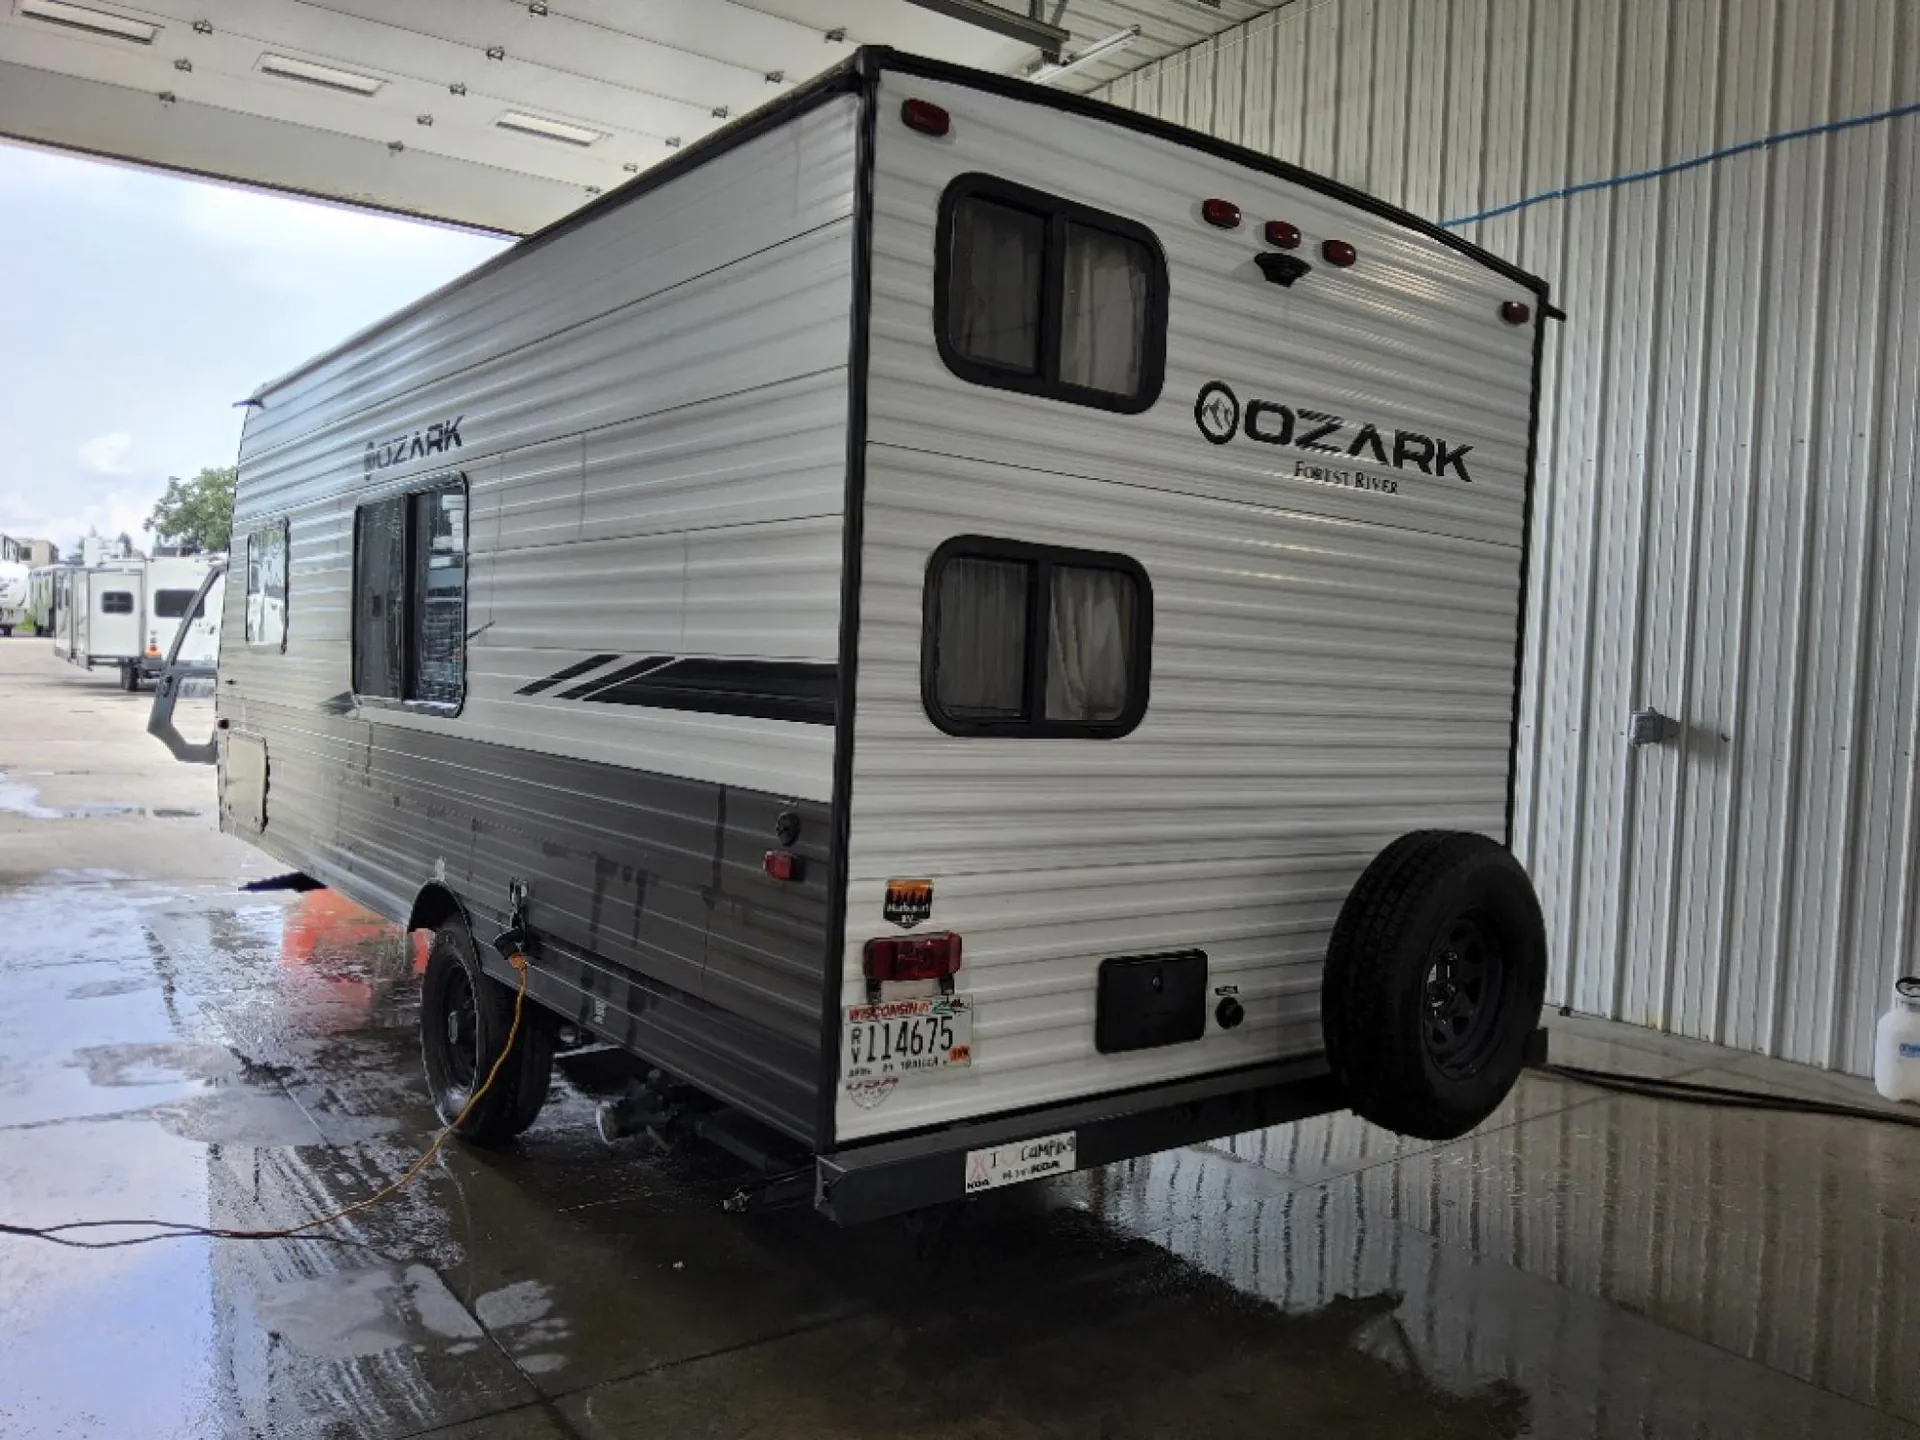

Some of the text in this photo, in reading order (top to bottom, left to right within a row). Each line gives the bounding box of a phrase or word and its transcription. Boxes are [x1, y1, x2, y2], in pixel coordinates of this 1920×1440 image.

[376, 415, 464, 469] OZARK
[1245, 399, 1474, 482] OZARK
[850, 1001, 917, 1021] WISCONSIN
[867, 1015, 953, 1062] 114675
